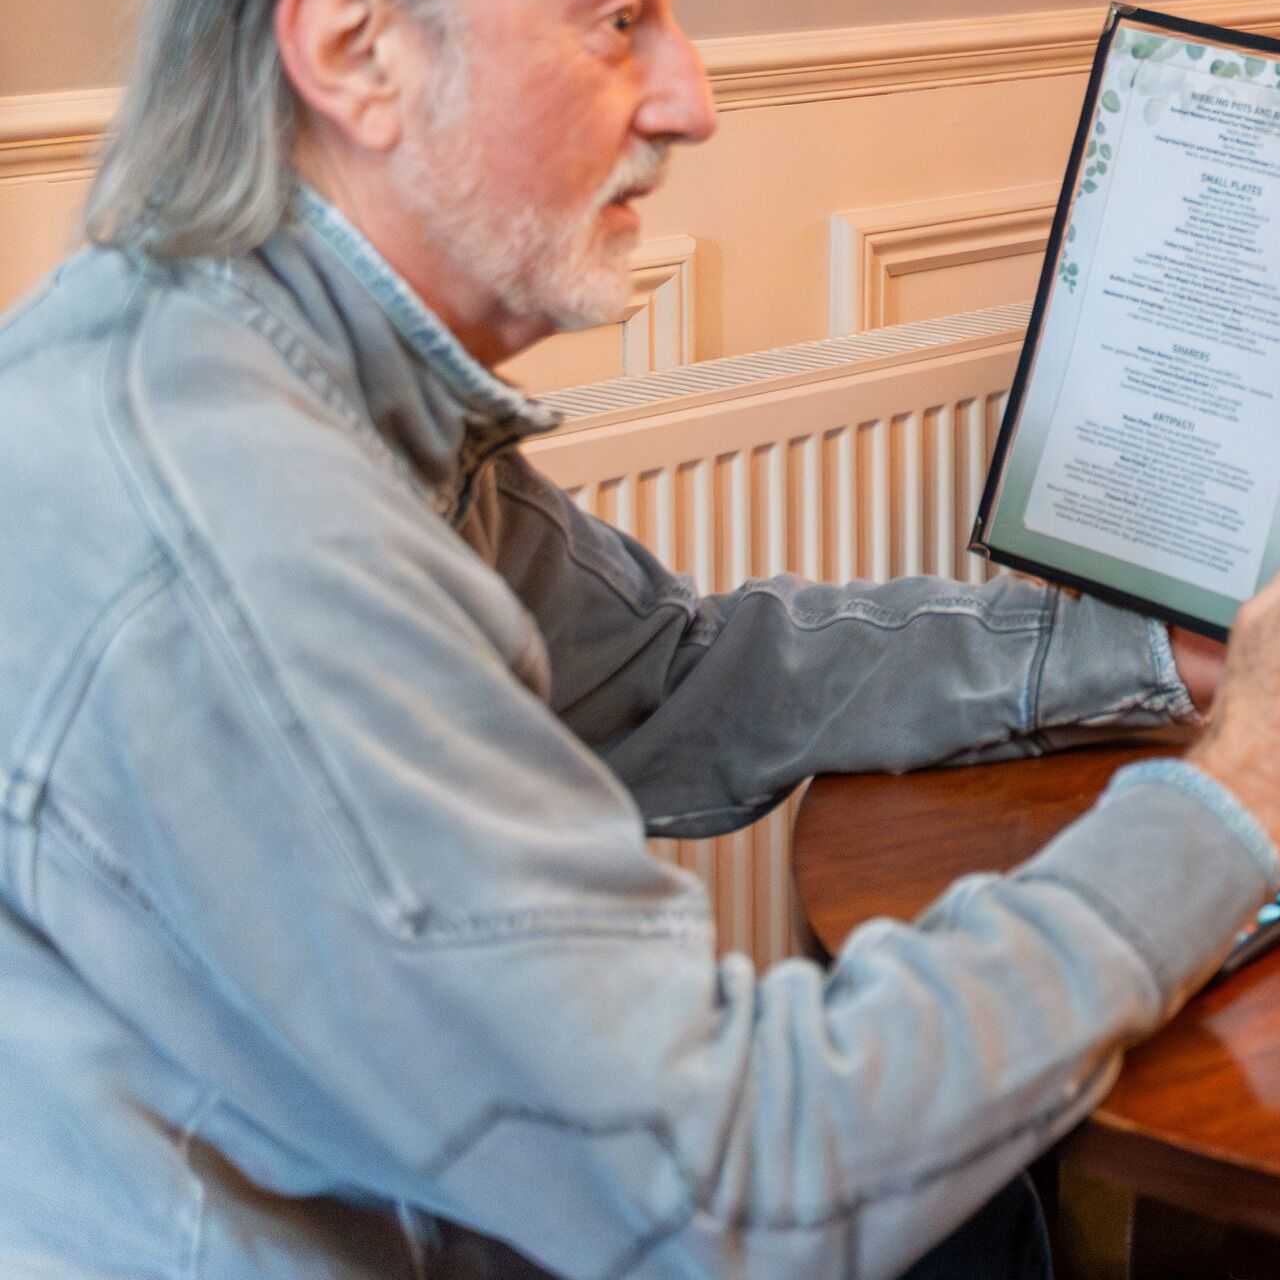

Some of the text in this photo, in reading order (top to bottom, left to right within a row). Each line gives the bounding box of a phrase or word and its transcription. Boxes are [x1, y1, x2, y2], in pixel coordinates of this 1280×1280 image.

[1232, 101, 1251, 112] POTS
[1254, 106, 1272, 118] AND
[1201, 173, 1263, 196] SMALL PLATES
[1172, 344, 1211, 362] SHARERS
[1152, 412, 1195, 431] ANTIPASTI
